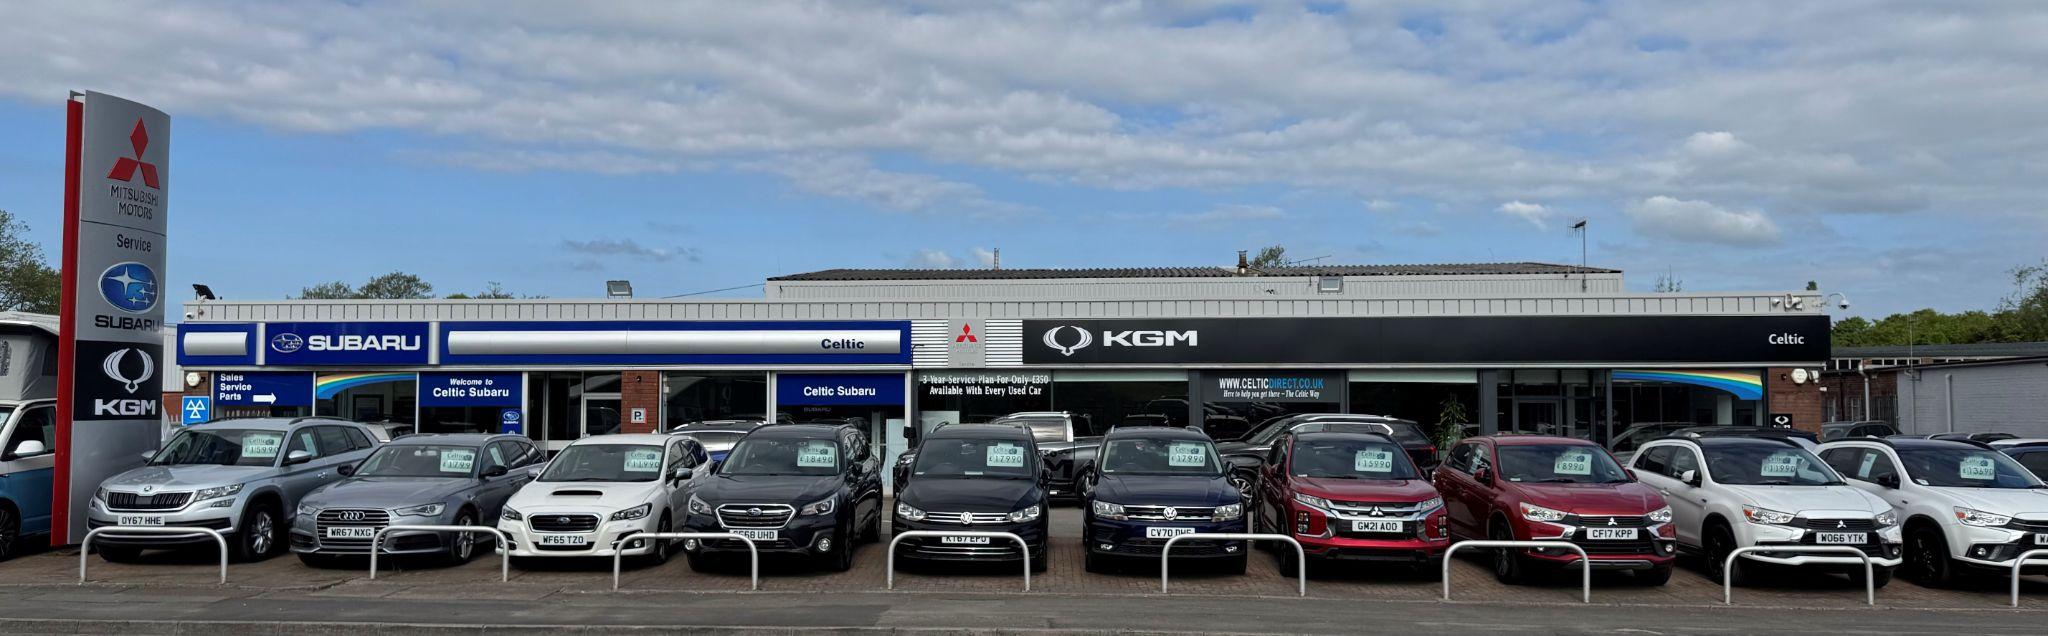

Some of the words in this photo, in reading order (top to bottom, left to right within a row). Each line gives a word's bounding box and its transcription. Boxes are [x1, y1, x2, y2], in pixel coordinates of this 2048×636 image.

[110, 185, 159, 207] MITSUBISHI
[117, 203, 153, 220] MOTORS
[116, 233, 152, 252] Service
[94, 315, 160, 332] SUBARU
[308, 335, 421, 351] SUBARU
[1103, 330, 1198, 347] KGM
[1768, 333, 1804, 345] Celtic
[821, 338, 865, 349] Celtic
[220, 373, 244, 382] Sales
[450, 378, 483, 386] Welcome
[485, 378, 494, 386] to
[922, 375, 928, 384] 3
[930, 375, 946, 384] Year
[948, 375, 976, 384] Service
[978, 375, 994, 384] Plan
[996, 375, 1009, 384] For
[1011, 375, 1029, 386] Only
[1031, 375, 1049, 384] £350
[220, 382, 252, 391] Service
[1219, 377, 1324, 390] WWW.CELTICDIRECT.CO.UK
[433, 387, 466, 397] Celtic
[469, 387, 509, 397] Subaru
[803, 386, 835, 396] Celtic
[837, 386, 876, 396] Subaru
[929, 386, 963, 395] Available
[965, 386, 982, 395] With
[985, 386, 1006, 397] Every
[1008, 386, 1026, 395] Used
[1028, 386, 1042, 395] Car
[1223, 390, 1234, 398] Here
[1234, 390, 1240, 398] to
[1240, 390, 1251, 399] help
[1251, 391, 1260, 399] you
[1268, 390, 1280, 398] there
[1285, 390, 1294, 398] The
[1294, 390, 1309, 398] Celtic
[1309, 390, 1320, 399] Way
[219, 392, 242, 401] Parts
[94, 398, 156, 416] KGM
[442, 461, 471, 469] £1799
[121, 516, 143, 525] OY67
[144, 516, 162, 525] HHE
[1357, 521, 1378, 530] GM21
[331, 528, 352, 536] WR67
[757, 530, 774, 539] UHD
[1150, 528, 1173, 537] CY70
[1592, 529, 1614, 538] CF17
[1615, 529, 1632, 538] KPP
[543, 535, 565, 543] WF65
[1847, 533, 1864, 542] YTK
